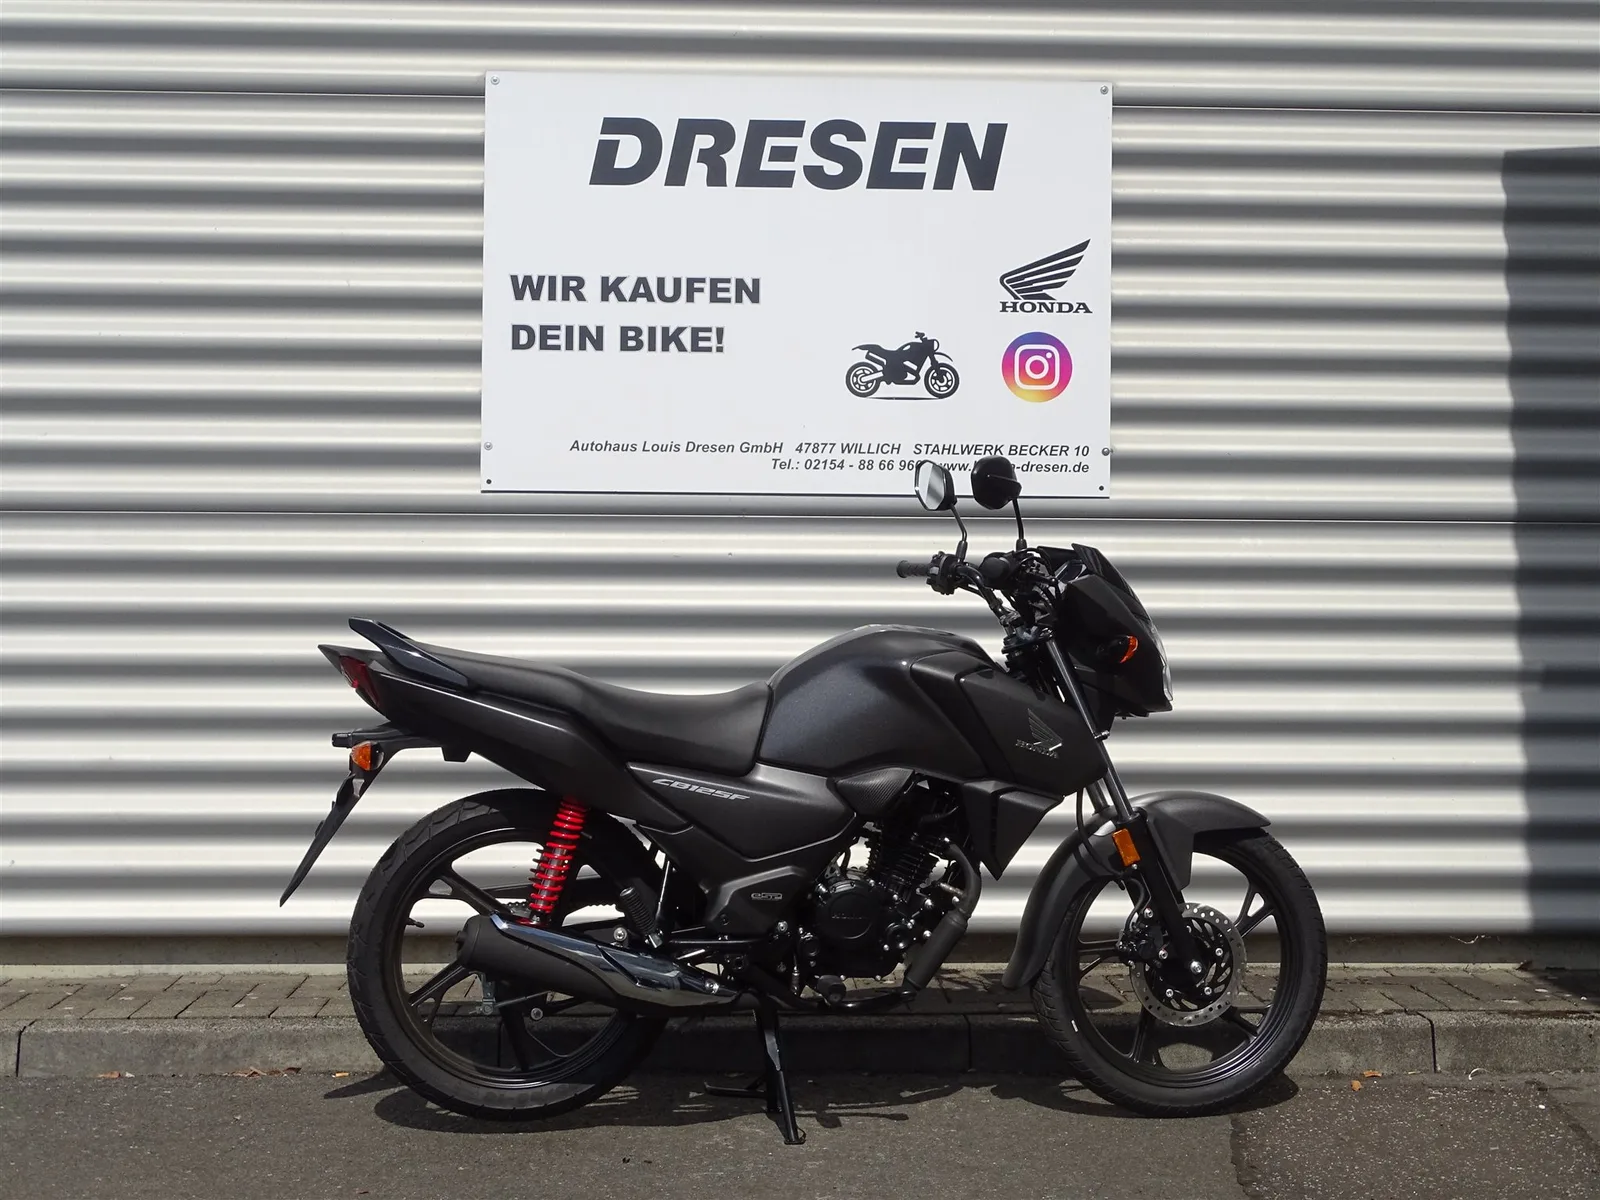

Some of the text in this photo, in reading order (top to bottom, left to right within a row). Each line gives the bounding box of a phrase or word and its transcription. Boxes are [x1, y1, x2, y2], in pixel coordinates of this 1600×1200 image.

[589, 117, 1008, 190] DRESEN
[510, 275, 761, 303] WIR KAUFEN
[999, 301, 1093, 314] HONDA
[511, 325, 725, 352] DEIN BIKE!
[569, 440, 1090, 457] Autohaus Louis Dresen GmbH 47877 WILLICH STAHLWERK BECKER 10
[772, 459, 800, 470] Tel.:
[805, 459, 845, 471] 02154
[858, 460, 875, 471] 88
[879, 460, 895, 471] 66
[652, 778, 751, 800] CB125F
